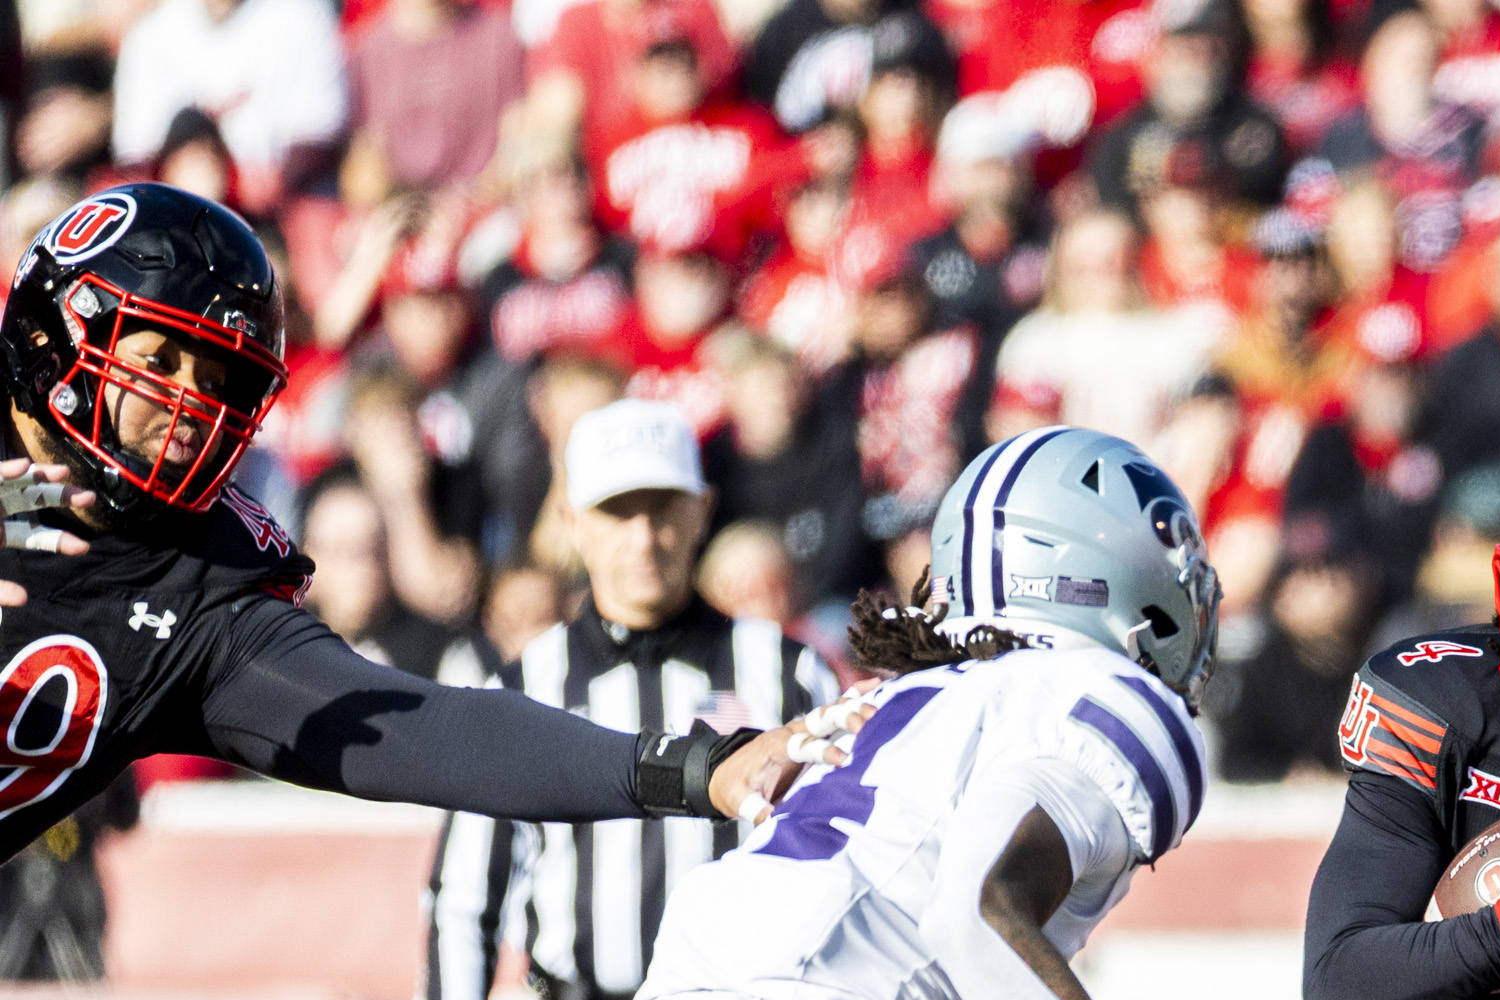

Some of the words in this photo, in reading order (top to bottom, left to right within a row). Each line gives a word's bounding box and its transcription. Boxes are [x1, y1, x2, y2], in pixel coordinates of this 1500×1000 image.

[55, 202, 128, 254] U
[946, 576, 956, 601] 4
[1397, 641, 1484, 667] 4
[0, 633, 109, 821] 9
[1449, 843, 1482, 879] ISSUE
